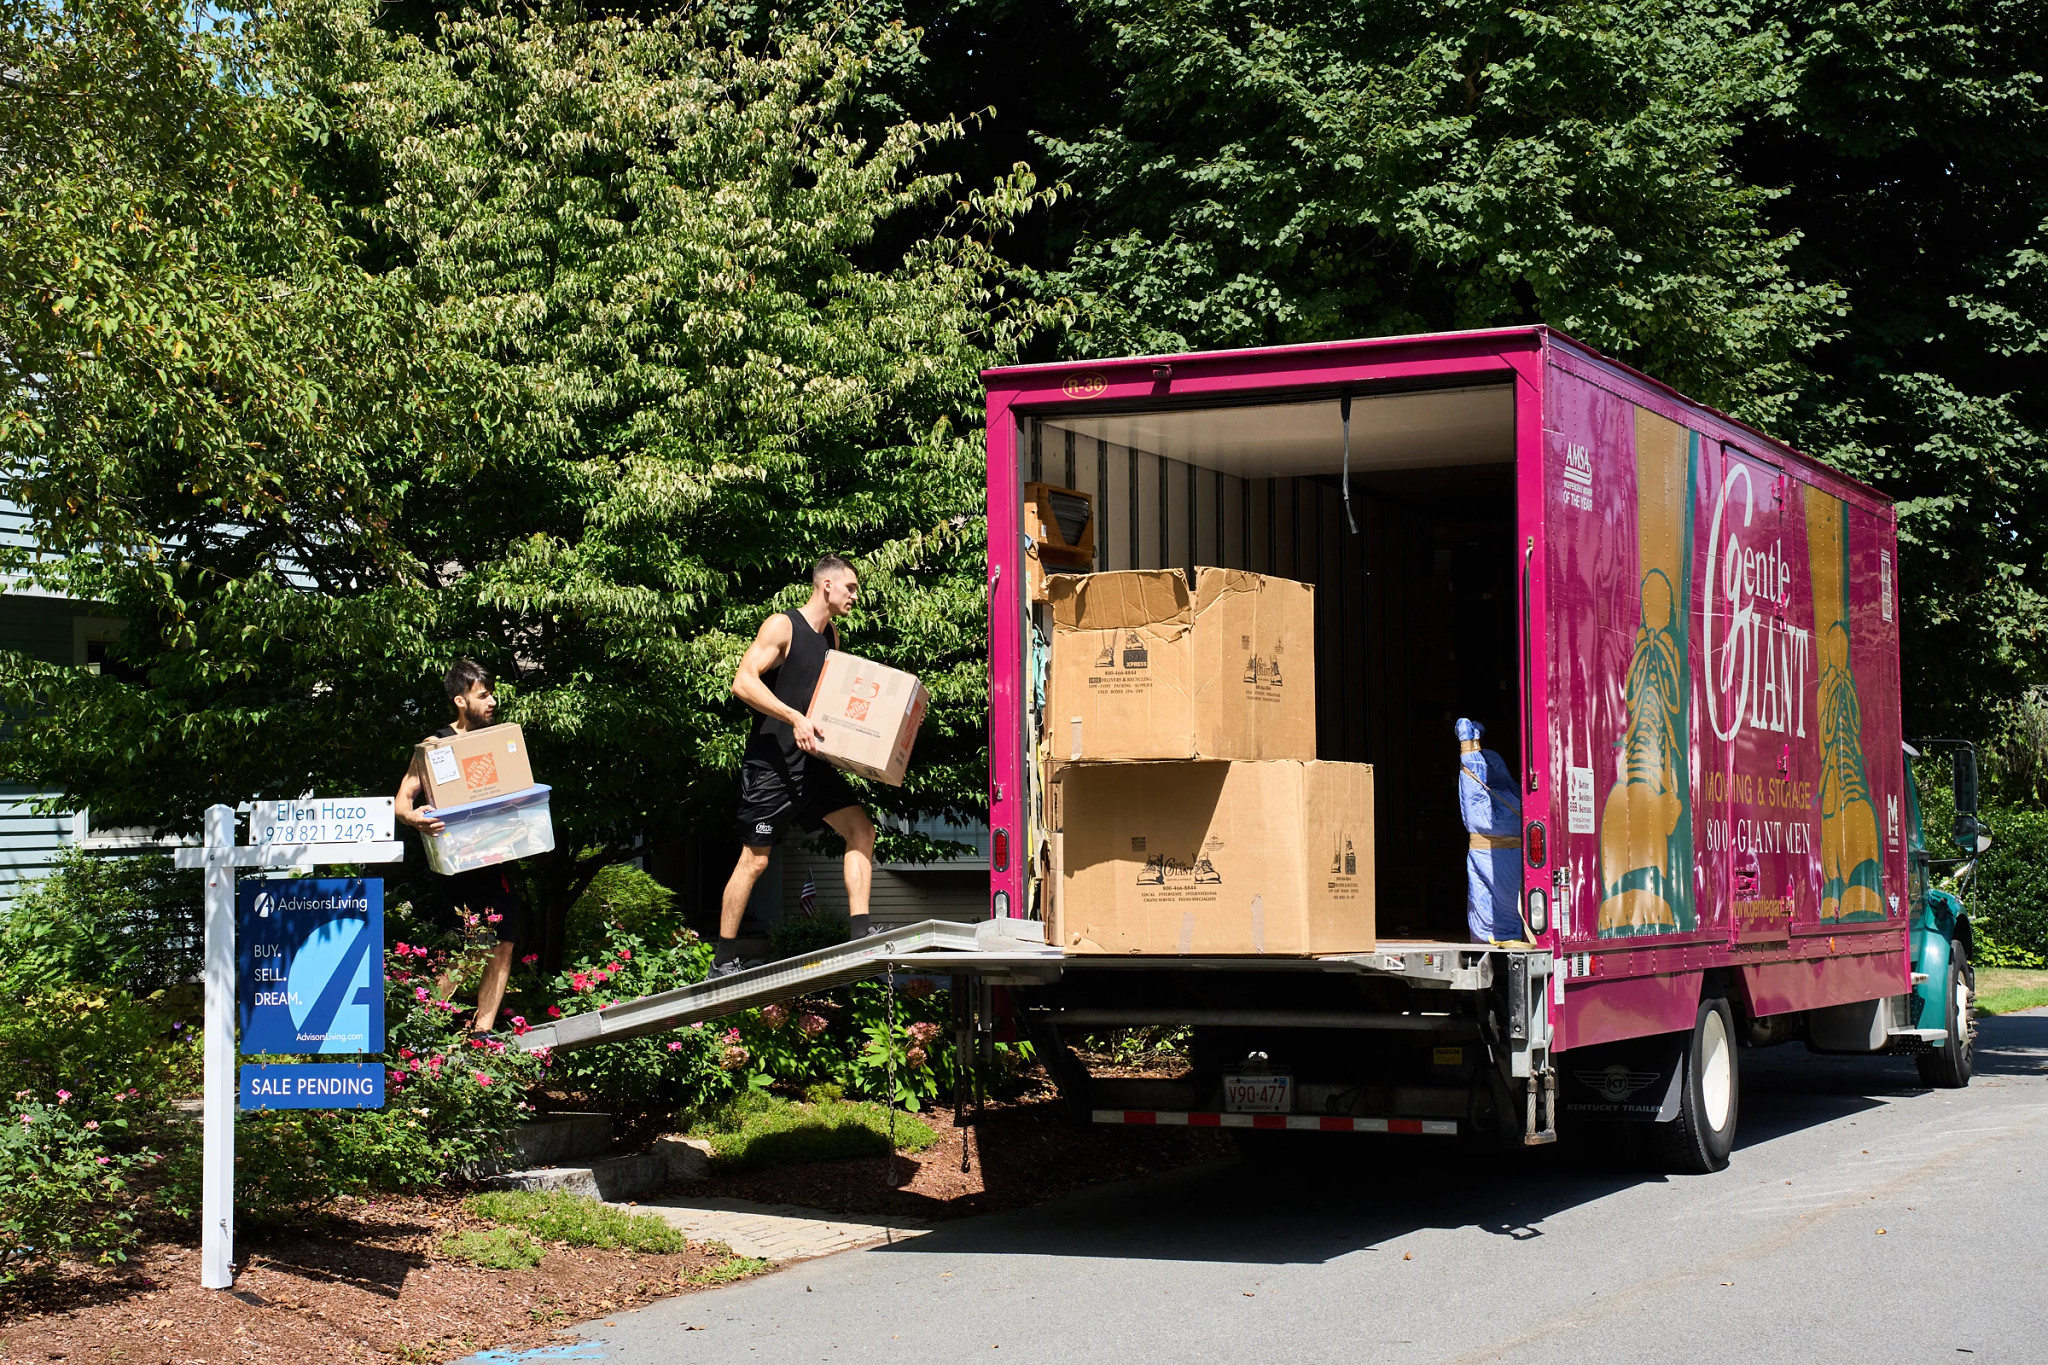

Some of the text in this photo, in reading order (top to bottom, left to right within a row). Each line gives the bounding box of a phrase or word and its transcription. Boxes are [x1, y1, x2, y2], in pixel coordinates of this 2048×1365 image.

[1068, 377, 1103, 393] R-36
[1565, 441, 1591, 473] AMSA
[1563, 490, 1593, 513] OF THE YEAR
[467, 753, 495, 788] HOME
[1757, 776, 1765, 806] &
[277, 802, 367, 822] Ellen Hazo
[1569, 801, 1578, 812] BBB
[266, 823, 375, 842] 978 821 2425
[278, 896, 368, 912] AdvisorsLiving
[254, 944, 282, 958] BUY.
[254, 968, 287, 982] SELL.
[254, 992, 302, 1006] DREAM.
[296, 1032, 363, 1042] AdvisorsLiving.com
[252, 1078, 373, 1095] SALE PENDING
[1567, 1104, 1620, 1112] KENTUCKY
